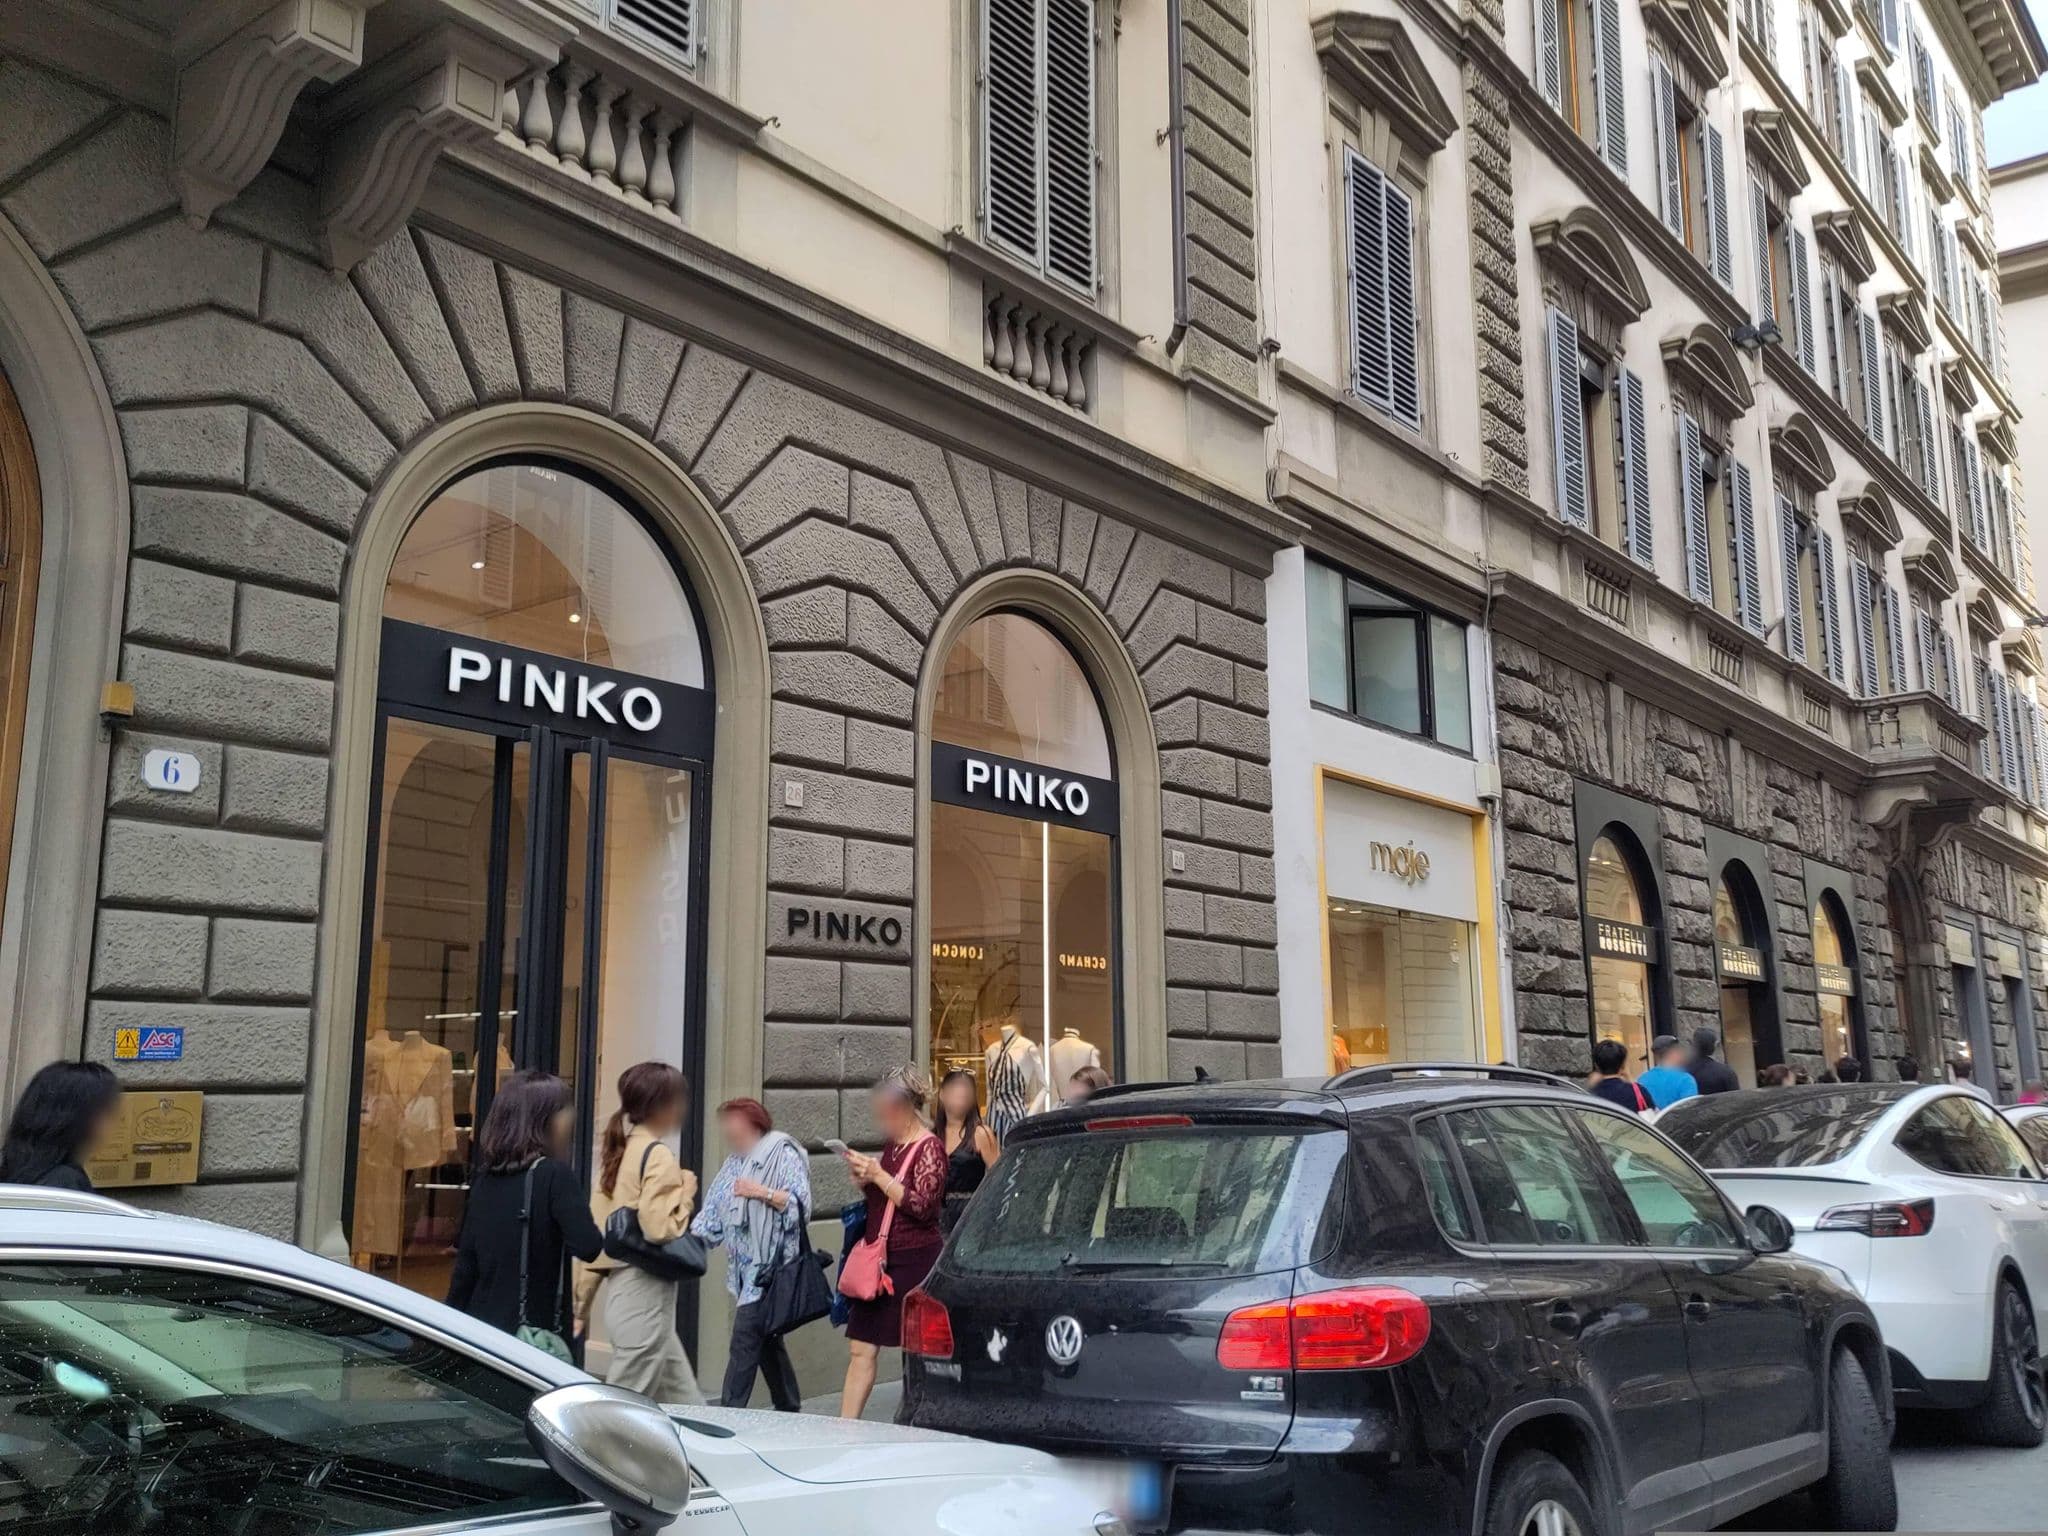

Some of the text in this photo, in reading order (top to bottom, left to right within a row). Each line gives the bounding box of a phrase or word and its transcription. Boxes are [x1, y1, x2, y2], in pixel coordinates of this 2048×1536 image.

[446, 646, 663, 732] PINKO
[163, 757, 180, 784] 6
[963, 758, 1090, 816] PINKO
[1369, 839, 1432, 886] maje
[787, 907, 903, 946] PINKO
[1598, 923, 1647, 944] FRATELLI
